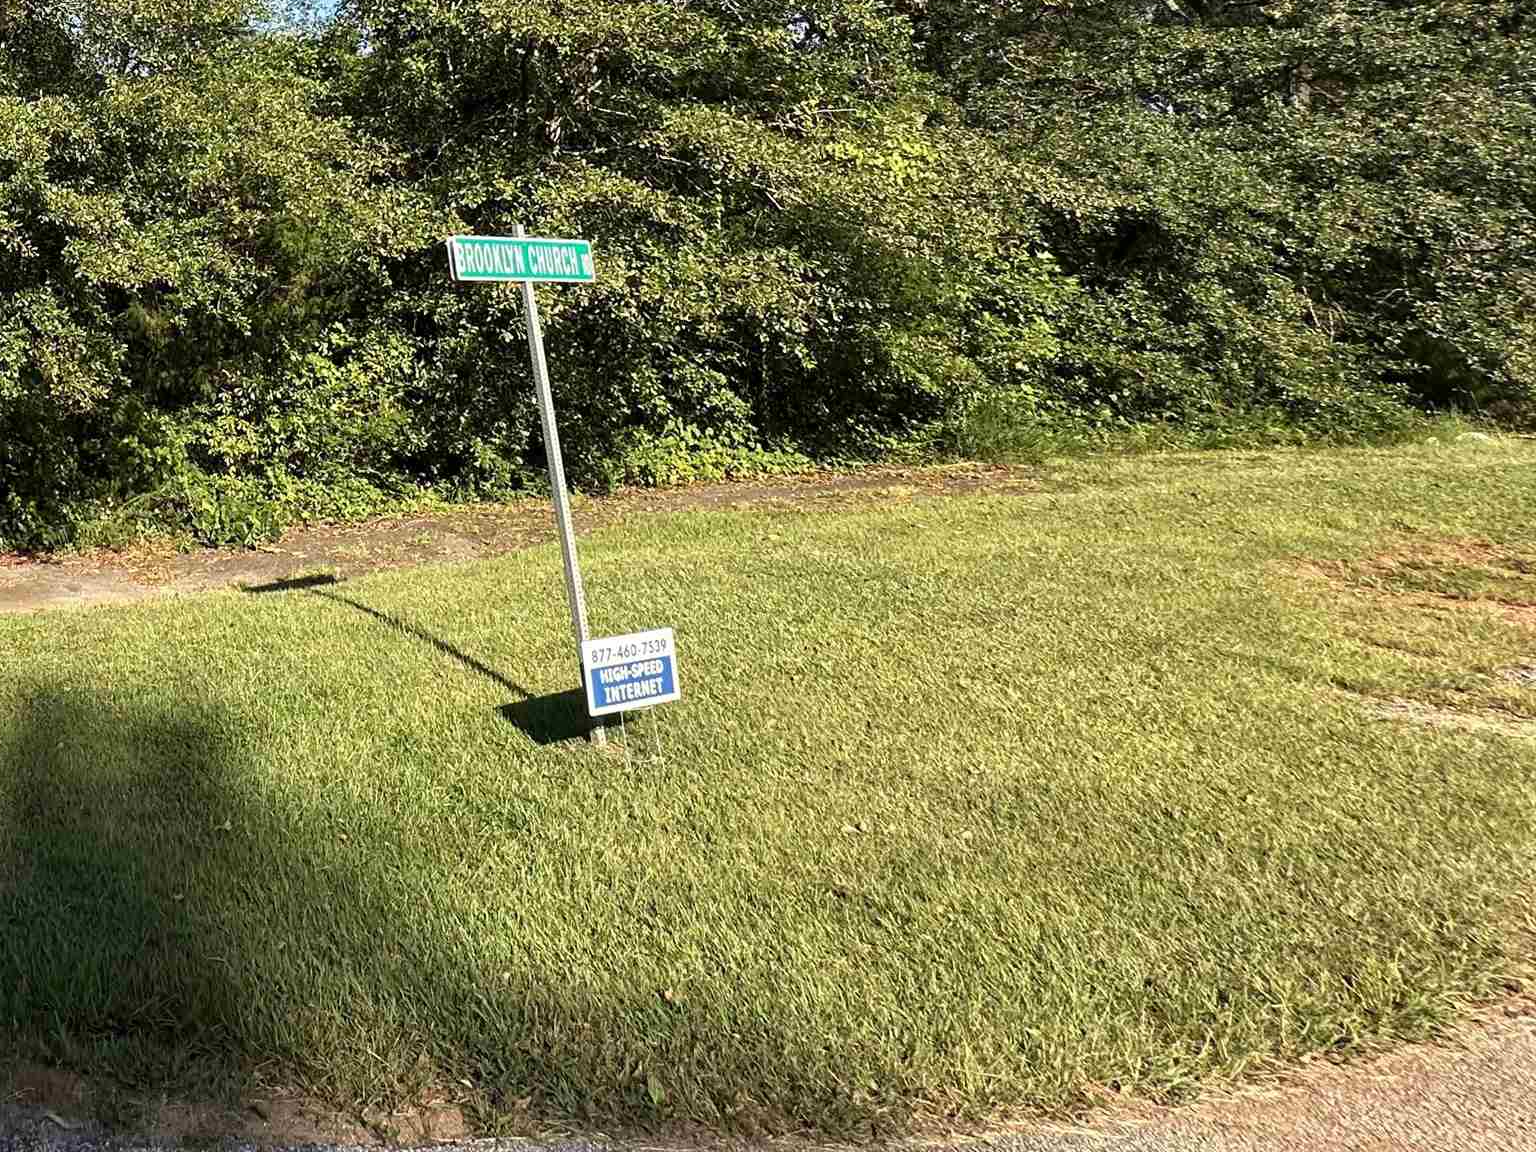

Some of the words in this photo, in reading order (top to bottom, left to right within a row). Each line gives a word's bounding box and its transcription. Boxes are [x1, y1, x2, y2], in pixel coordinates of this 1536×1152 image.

[455, 241, 525, 274] BROOKLYN
[527, 244, 580, 276] CHURCH
[599, 659, 664, 684] HIGH-SPEED
[604, 677, 664, 703] INTERNET
